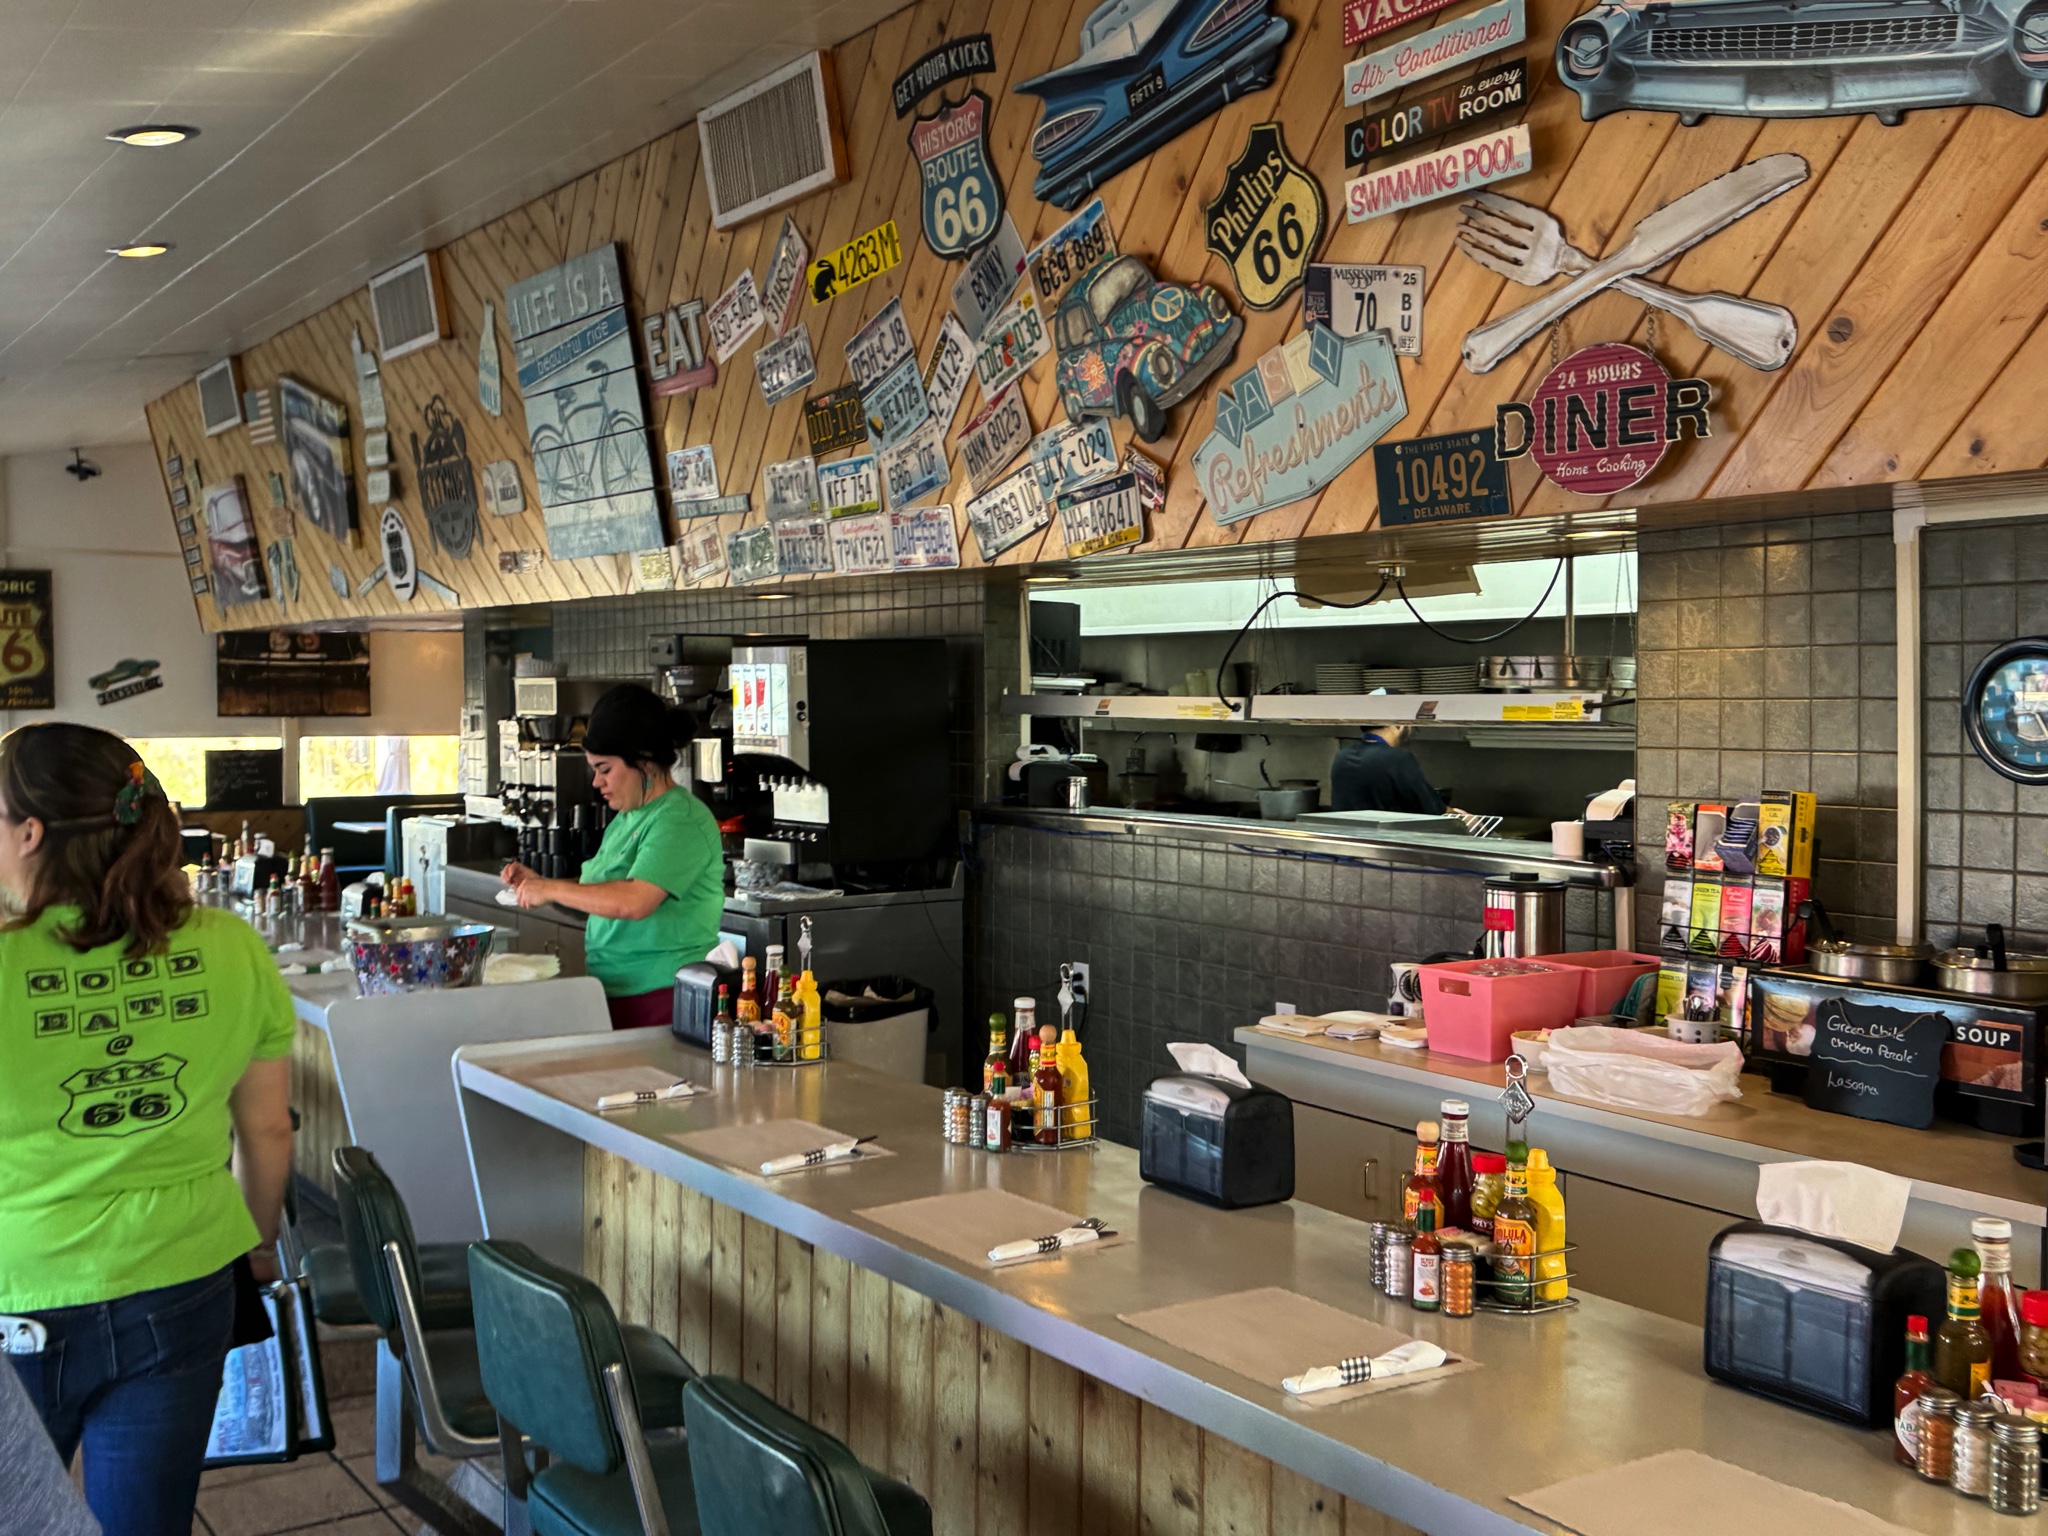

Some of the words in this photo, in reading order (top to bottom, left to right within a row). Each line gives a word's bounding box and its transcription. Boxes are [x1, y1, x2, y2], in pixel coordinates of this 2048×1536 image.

[895, 73, 916, 108] GET
[915, 53, 948, 90] YOUR
[948, 40, 989, 70] KICKS
[1351, 10, 1513, 95] Air-Conditioned
[1459, 84, 1475, 98] in
[1478, 67, 1522, 91] every
[919, 111, 977, 156] HISTORIC
[1351, 106, 1423, 158] COLOR
[1427, 92, 1455, 129] TV
[1459, 83, 1521, 119] ROOM
[925, 143, 979, 188] ROUTE
[1350, 155, 1460, 217] SWIMMING
[1463, 136, 1514, 184] POOL
[934, 176, 987, 247] 66
[1211, 150, 1282, 254] Phillips
[1073, 223, 1105, 270] 889
[1253, 203, 1303, 284] 66
[566, 272, 589, 316] IS
[598, 263, 615, 307] A
[1333, 268, 1387, 289] MISSISSIPPI
[1403, 273, 1417, 285] 25
[587, 321, 609, 346] ride
[1355, 292, 1377, 333] 70
[642, 297, 704, 381] EAT
[1557, 371, 1576, 390] 24
[1586, 361, 1642, 385] HOURS
[987, 399, 1022, 451] 8025
[1209, 360, 1398, 514] Refreshments
[1495, 378, 1712, 462] DINER
[1446, 437, 1470, 450] STATE
[1396, 449, 1489, 505] 10492
[1556, 461, 1588, 478] Home
[1597, 454, 1647, 478] Cooking
[1414, 502, 1472, 519] DELAWARE
[30, 955, 199, 991] GOOD
[39, 997, 200, 1031] EATS
[1827, 1015, 1865, 1035] Green
[1870, 1023, 1906, 1042] Chile
[106, 1034, 133, 1056] @
[1957, 1026, 2012, 1047] SOUP
[84, 1062, 166, 1088] KIX
[1827, 1071, 1879, 1096] Lasagna
[83, 1093, 171, 1128] 66
